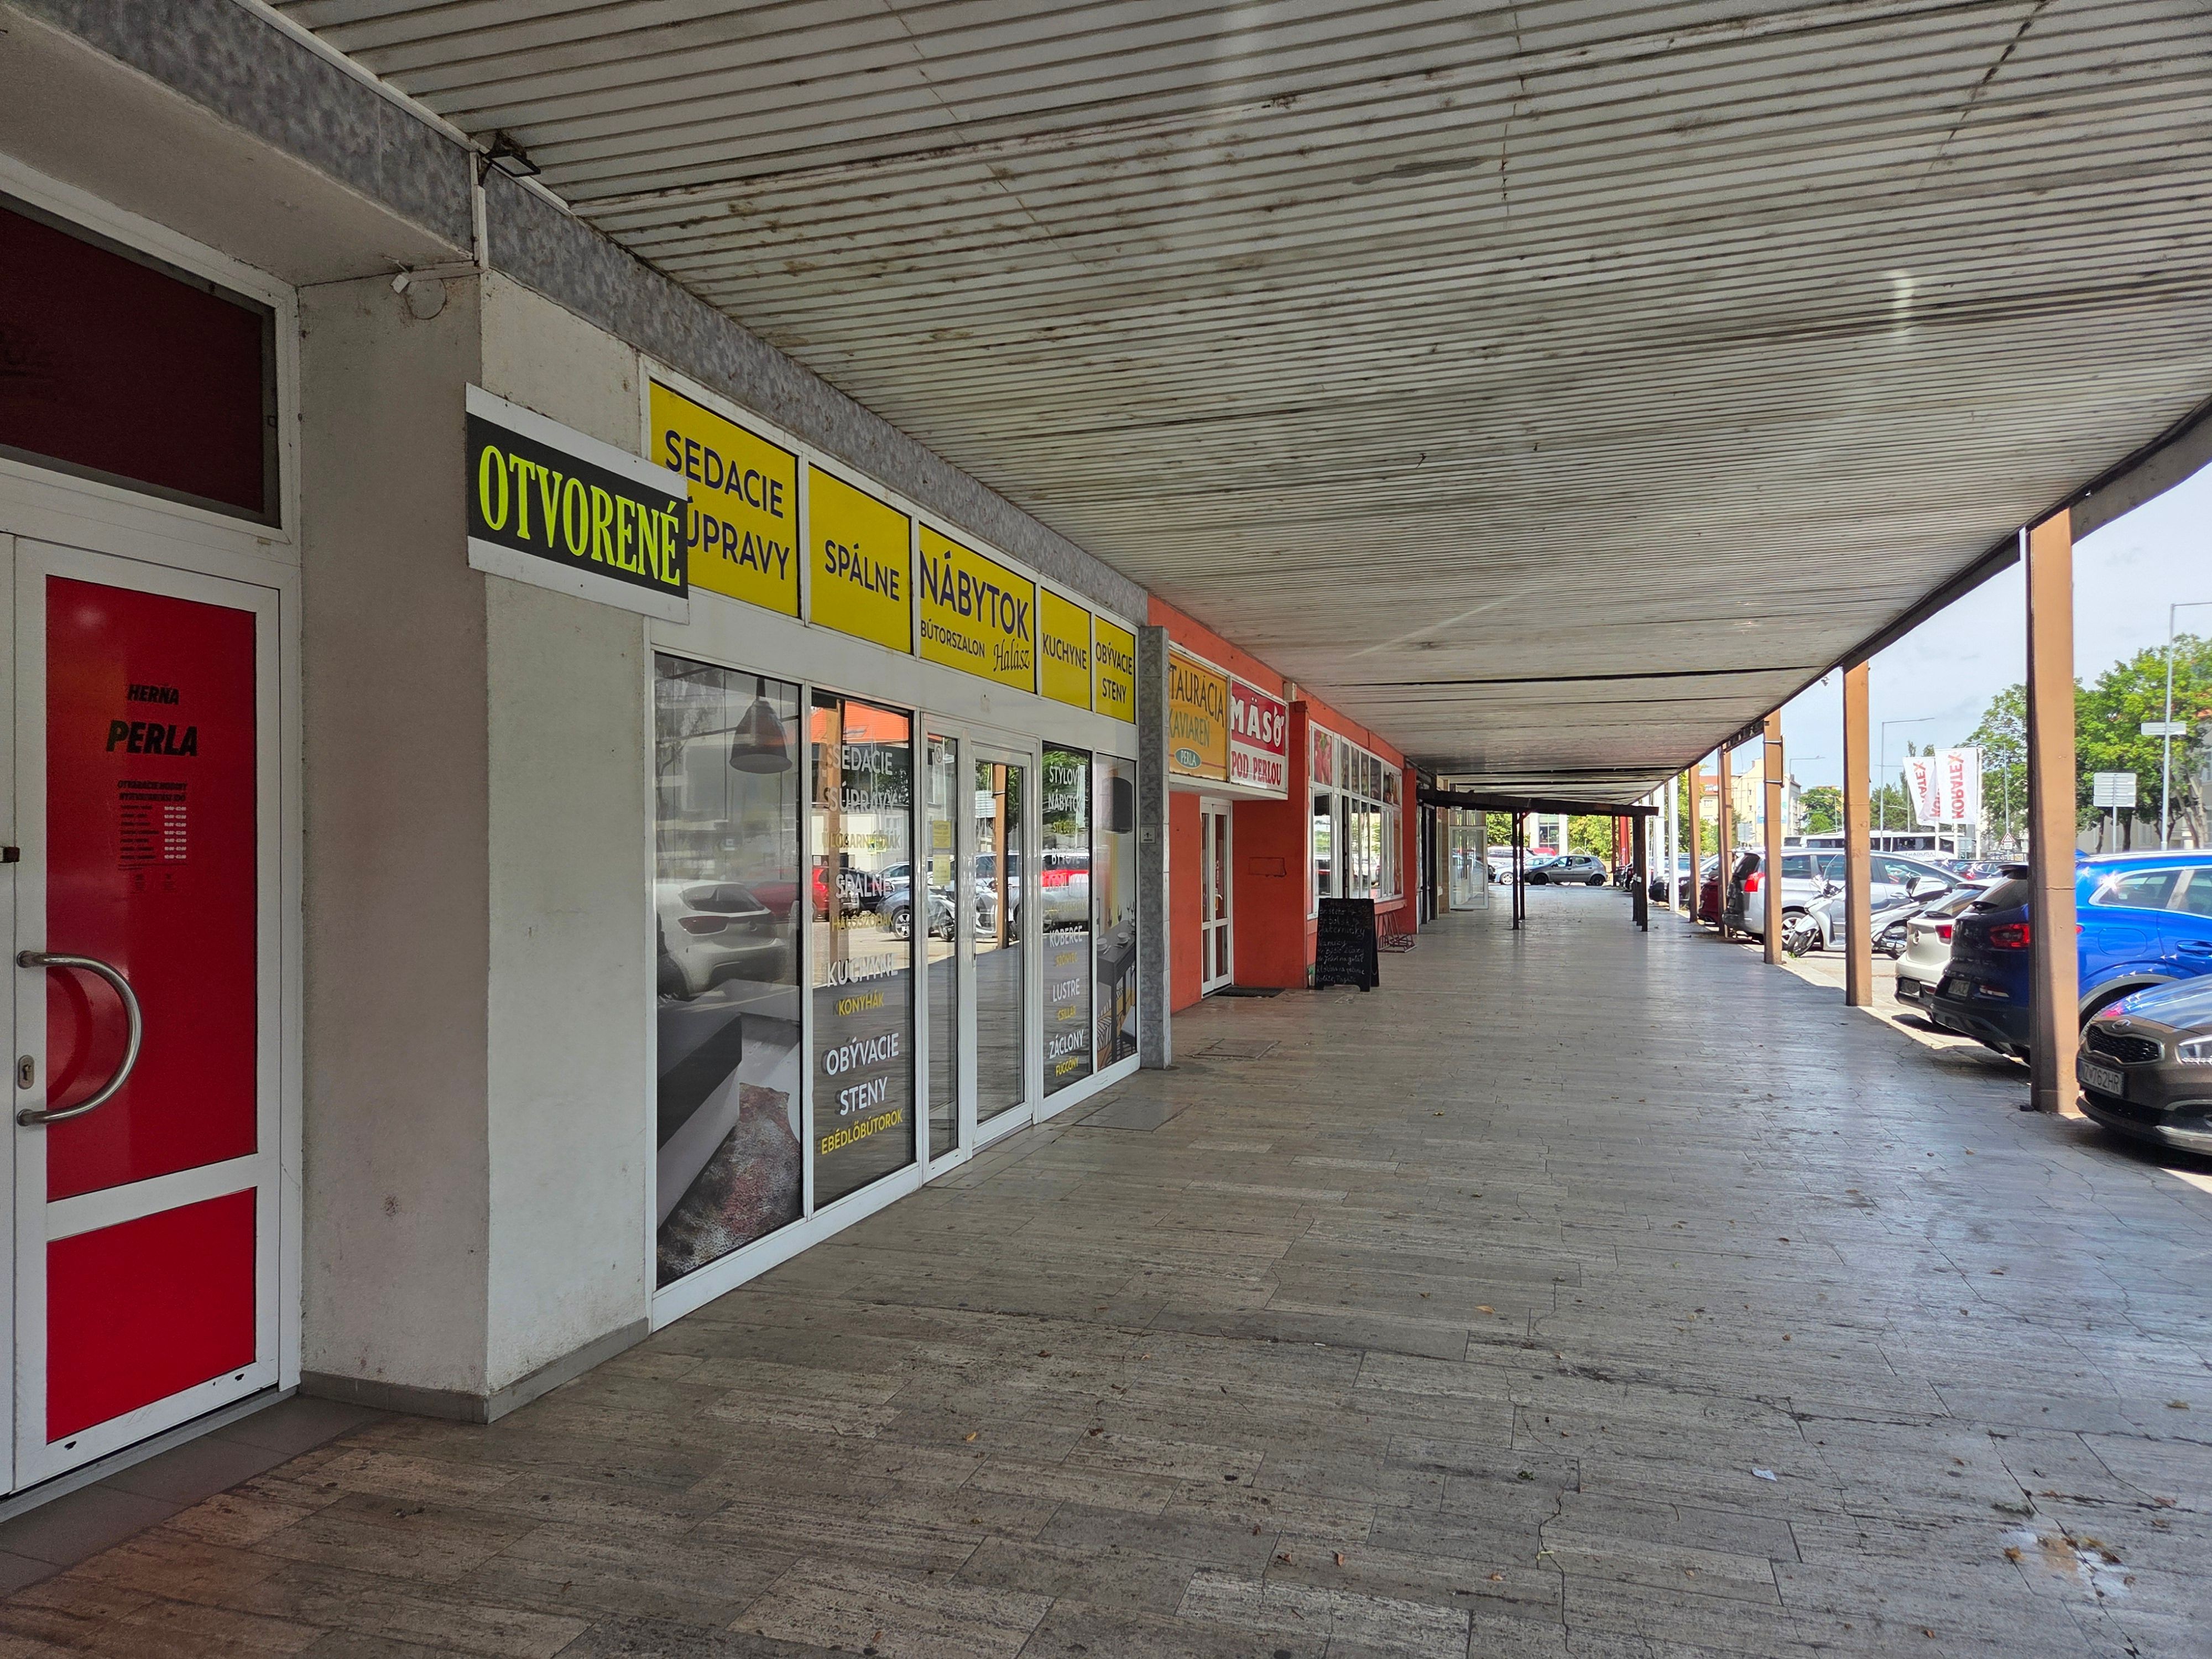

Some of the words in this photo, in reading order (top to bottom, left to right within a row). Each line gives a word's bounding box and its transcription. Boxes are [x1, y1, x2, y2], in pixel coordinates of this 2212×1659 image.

[665, 429, 784, 519] SEDACIE
[479, 445, 681, 586] OTVORENÉ
[687, 495, 790, 581] ÚPRAVY
[825, 539, 900, 602] SPÁLNE
[920, 550, 1029, 642] NÁBYTOK
[920, 618, 985, 659] BÚTORSZALON
[993, 638, 1030, 672] Halász
[1042, 632, 1087, 670] KUCHYNE
[1095, 640, 1133, 676] OBÝVACIE
[127, 684, 179, 706] HERNA
[1102, 677, 1127, 704] STENY
[1169, 664, 1224, 728] TAURÁCIA
[106, 719, 198, 757] PERLA
[832, 744, 893, 775] SEDACIE
[1180, 750, 1197, 767] PERLA
[1232, 751, 1249, 779] POD
[1253, 757, 1282, 786] PERLOU
[828, 780, 898, 813] SÚPRAVY
[1050, 925, 1083, 948] KOBERCE
[827, 952, 898, 988] KUCHYNE
[838, 989, 884, 1016] KONYHÁK
[1053, 978, 1080, 1003] LUSTRE
[826, 1032, 899, 1076] OBÝVACIE
[1049, 1029, 1084, 1059] ZÁCLONY
[839, 1076, 888, 1115] STENY
[821, 1108, 903, 1155] EBÉDLŐBÚTOROK
